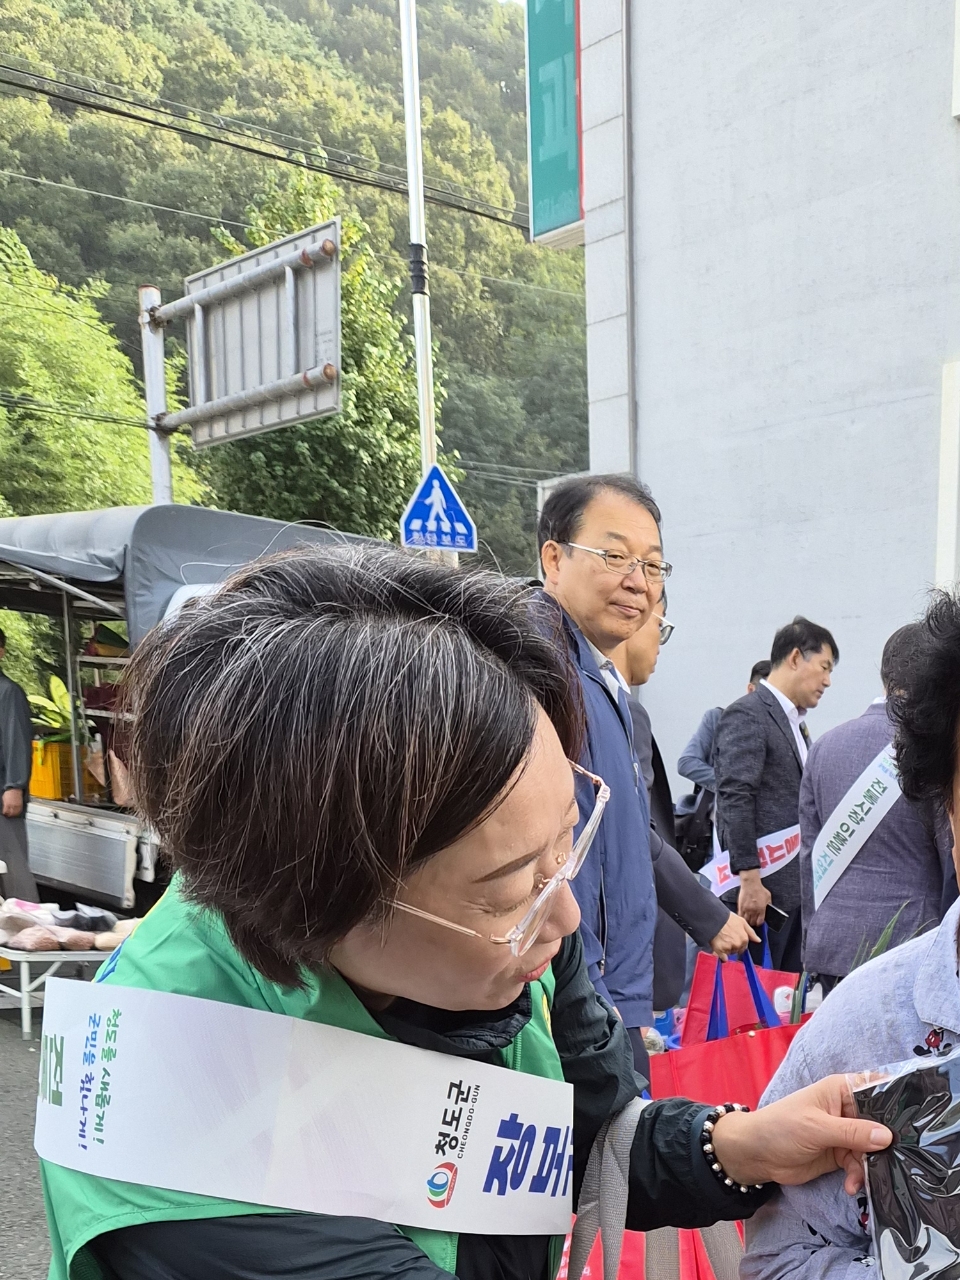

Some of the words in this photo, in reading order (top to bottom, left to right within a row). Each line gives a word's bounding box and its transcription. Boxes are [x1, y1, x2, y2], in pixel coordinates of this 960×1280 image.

[847, 777, 889, 826] 전통시장
[82, 1013, 102, 1067] 군민을
[100, 1008, 122, 1063] 청도를
[78, 1071, 95, 1151] 힘나게!
[92, 1066, 112, 1145] 새롭게!
[434, 1080, 472, 1157] 청도군
[457, 1084, 481, 1160] CHEONGDO-GUN
